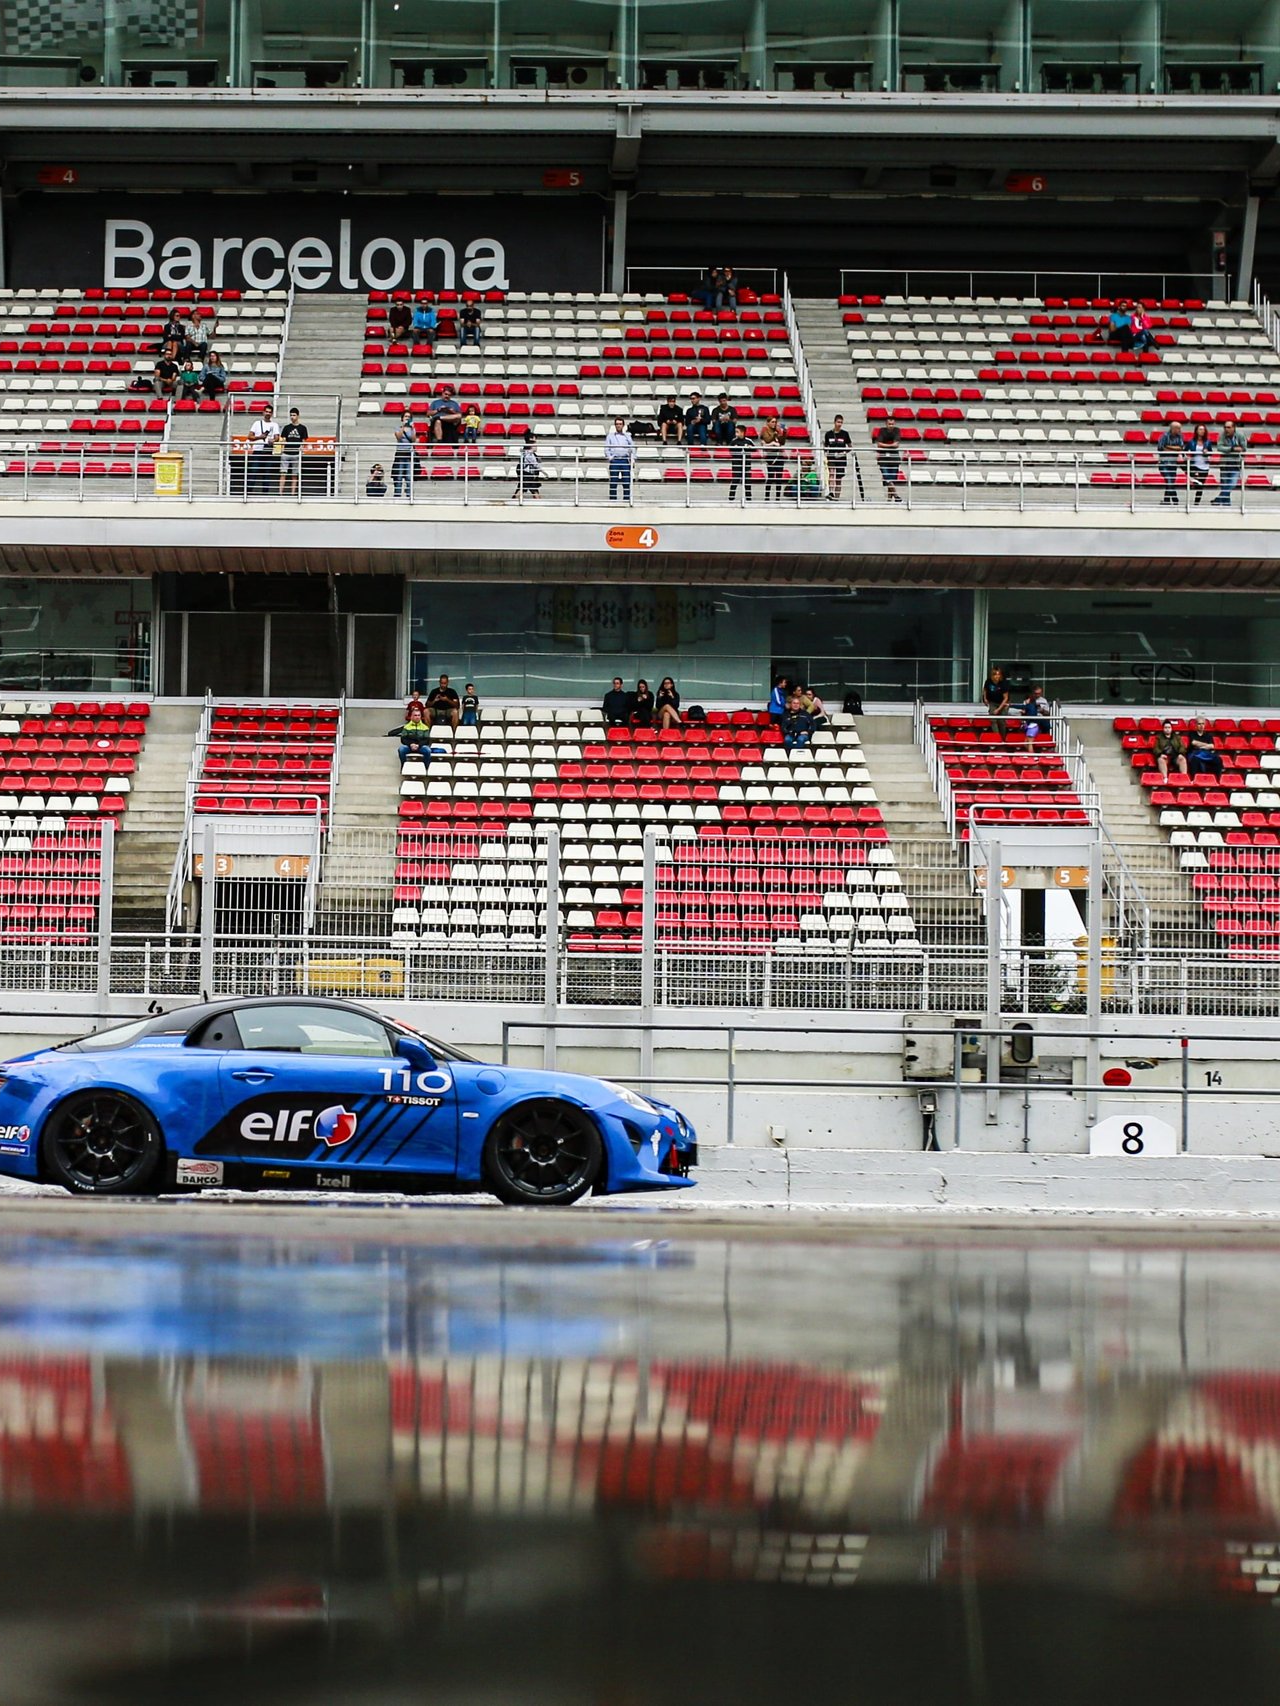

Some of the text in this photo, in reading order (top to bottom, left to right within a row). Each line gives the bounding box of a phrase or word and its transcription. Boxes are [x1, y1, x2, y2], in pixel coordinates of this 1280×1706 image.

[63, 169, 75, 184] 4
[569, 172, 580, 187] 5
[1032, 177, 1043, 192] 6
[103, 218, 510, 291] Barcelona
[638, 529, 655, 547] 4
[216, 858, 228, 872] 3
[280, 859, 291, 873] 4
[1060, 870, 1070, 883] 5
[377, 1067, 453, 1094] 110
[1204, 1070, 1223, 1087] 14
[402, 1096, 441, 1106] TISSOT
[239, 1109, 314, 1142] elf
[1121, 1122, 1144, 1155] 8
[182, 1175, 218, 1185] BAHCO
[316, 1173, 351, 1188] ixell
